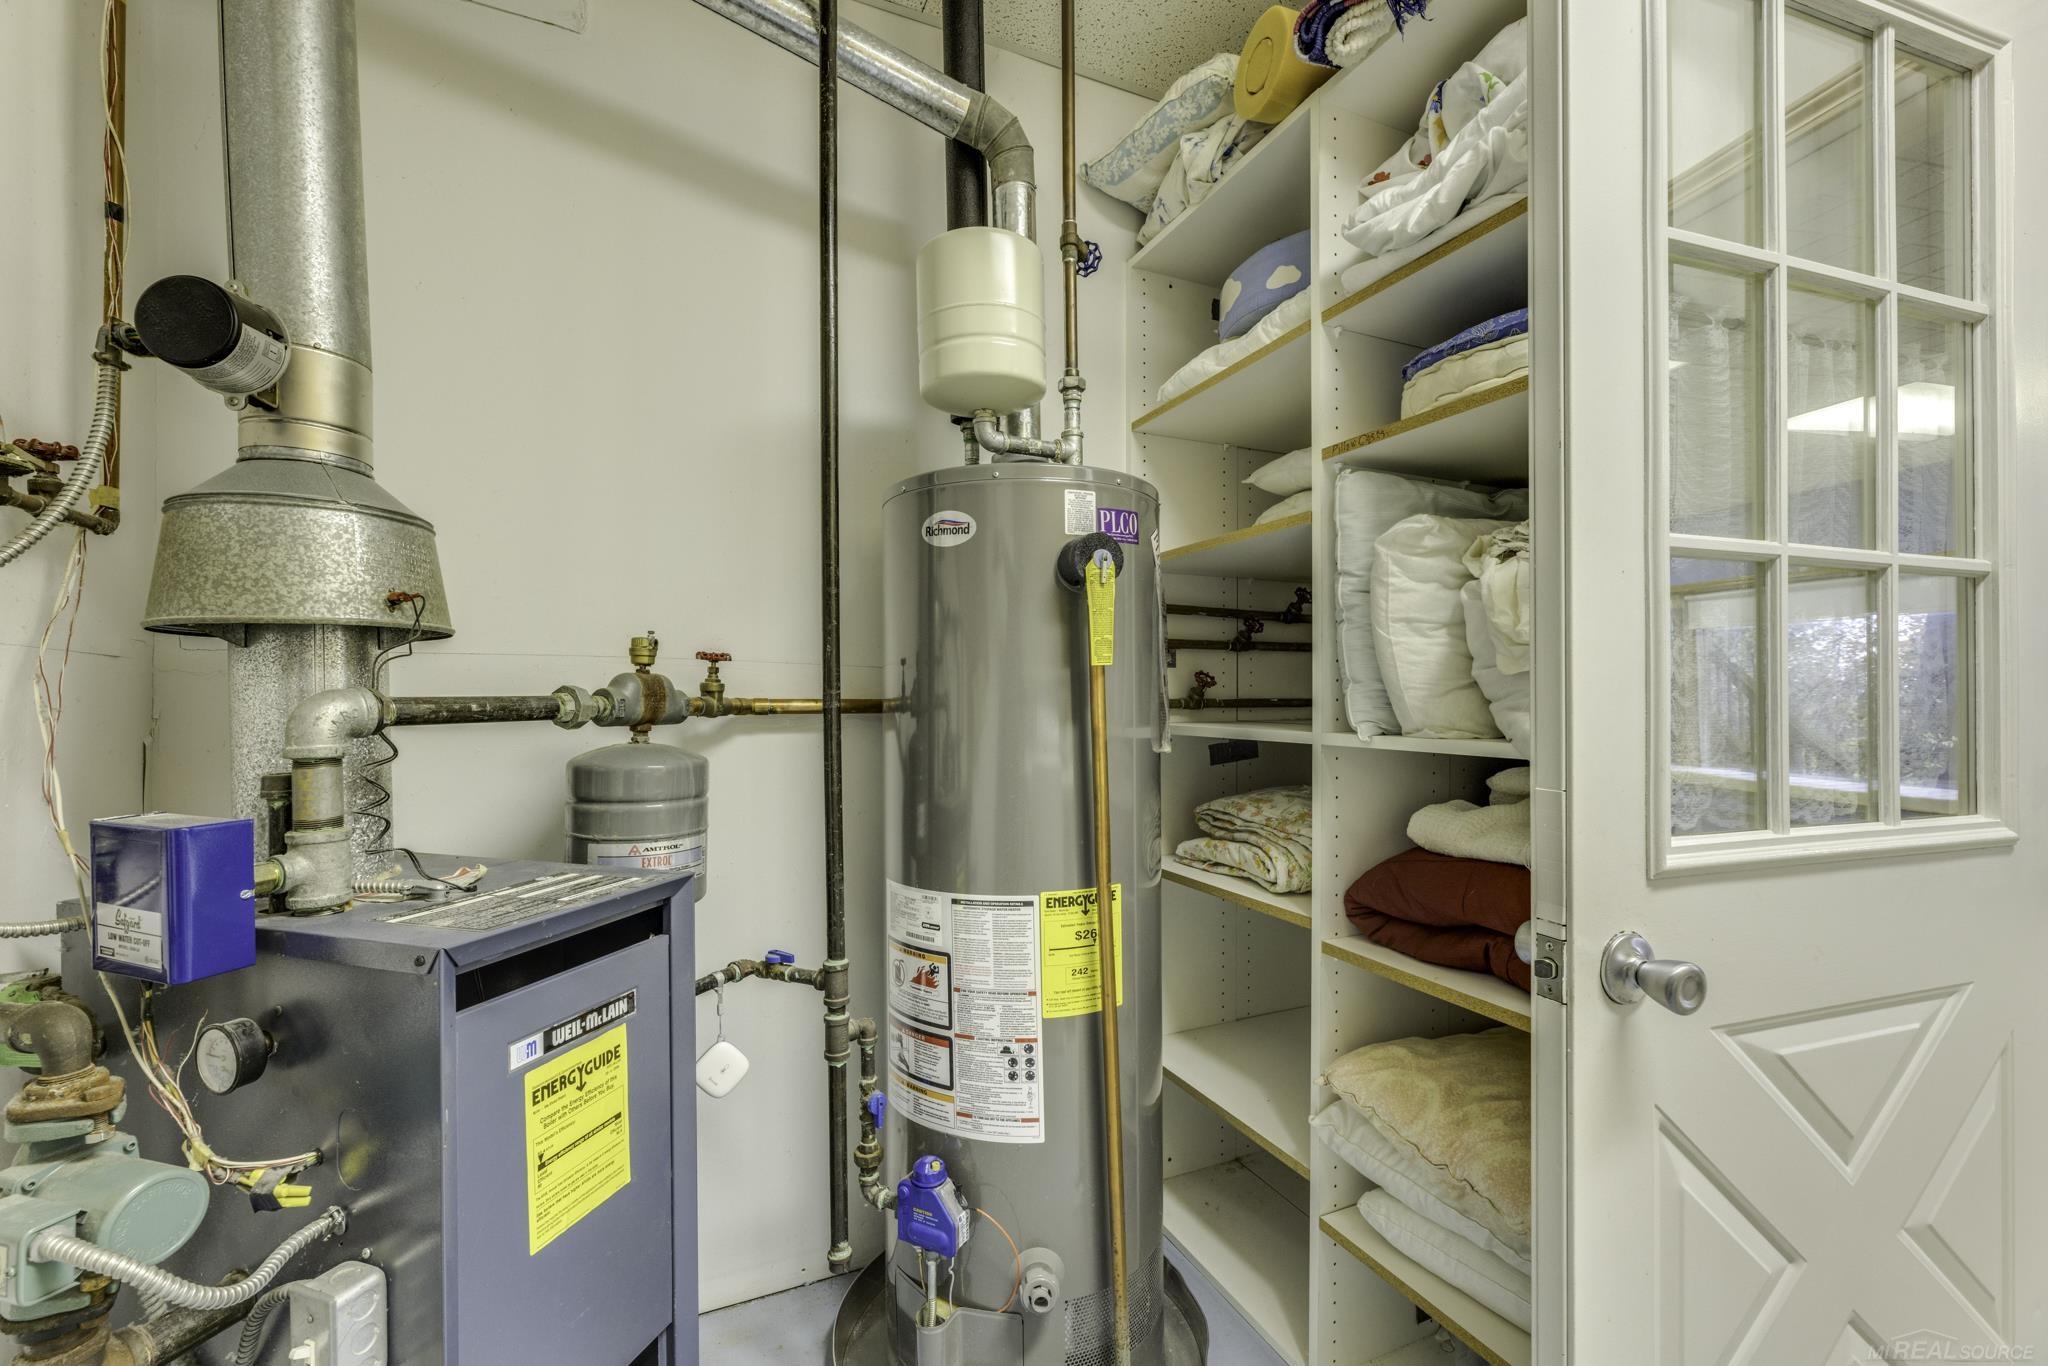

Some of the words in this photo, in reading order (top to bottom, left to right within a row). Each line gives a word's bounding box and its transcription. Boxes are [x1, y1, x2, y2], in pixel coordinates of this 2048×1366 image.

[925, 522, 970, 537] Richmond
[1100, 510, 1138, 535] PLCO
[641, 855, 673, 868] EXTROL
[1046, 890, 1117, 910] ENERGYGE
[1071, 967, 1089, 976] 242
[532, 1044, 621, 1107] ENERGYGUIDE
